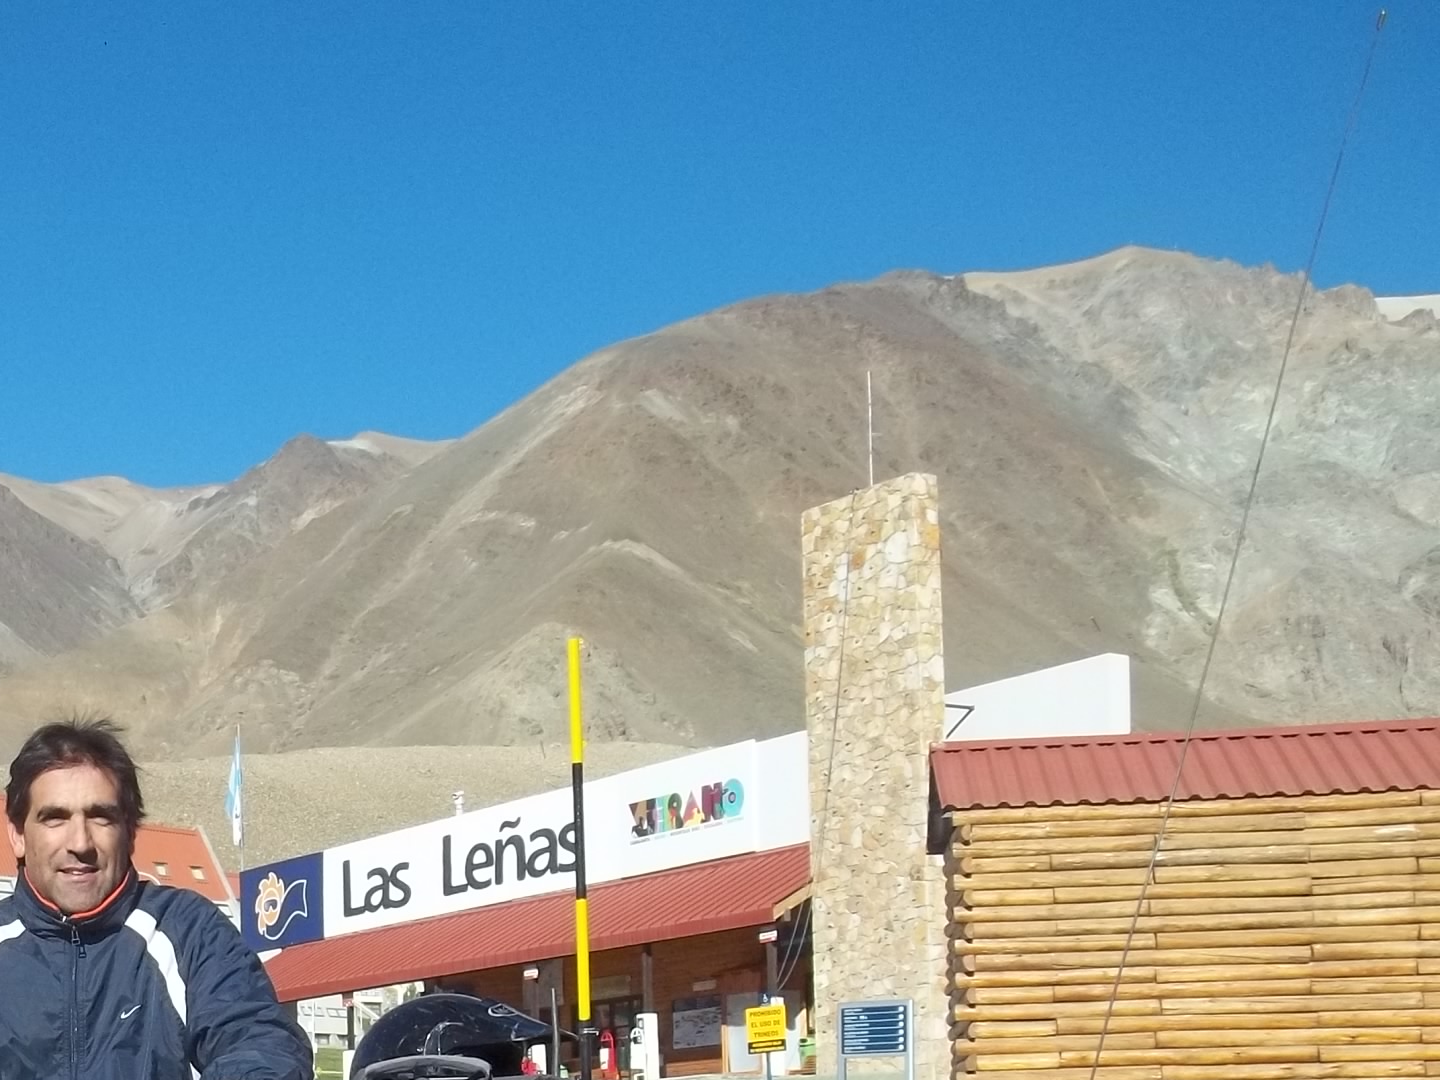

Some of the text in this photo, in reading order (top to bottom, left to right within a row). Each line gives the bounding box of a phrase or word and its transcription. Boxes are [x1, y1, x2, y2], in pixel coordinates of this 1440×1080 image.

[628, 778, 744, 838] VERANO
[342, 859, 412, 918] Las
[442, 816, 580, 897] Leñas
